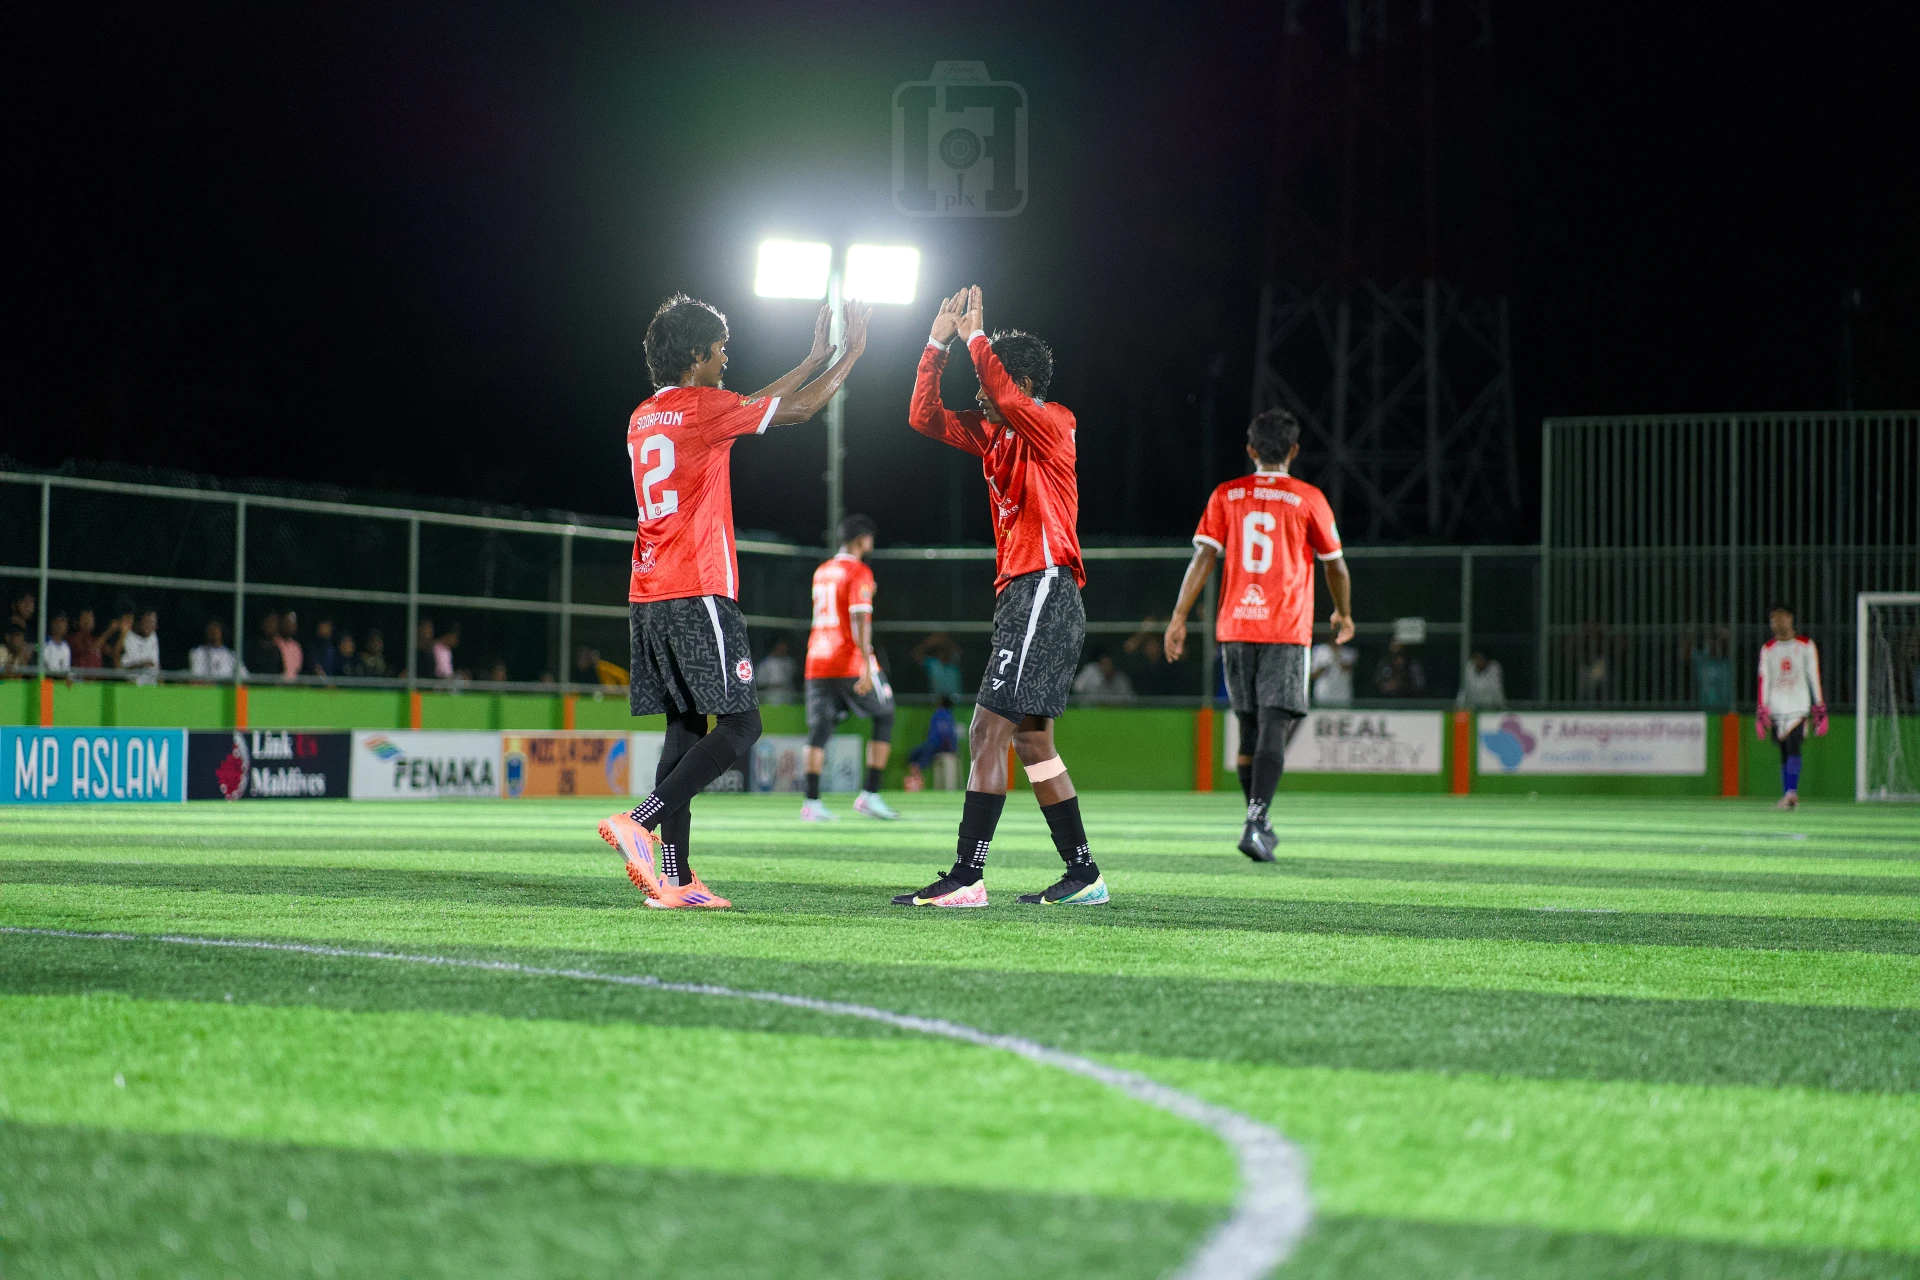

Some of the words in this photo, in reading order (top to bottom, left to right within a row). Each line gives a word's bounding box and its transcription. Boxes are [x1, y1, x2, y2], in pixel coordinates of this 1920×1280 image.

[637, 411, 684, 431] SCORPION
[627, 433, 679, 522] 12
[1253, 486, 1303, 508] SCORPION
[1242, 511, 1276, 574] 6
[1314, 716, 1395, 738] REAL
[251, 730, 294, 760] Link
[1316, 740, 1428, 766] JERSEY
[14, 735, 60, 799] MP
[71, 736, 170, 799] ASLAM
[250, 766, 327, 798] Maldives
[393, 756, 495, 790] FENAKA
